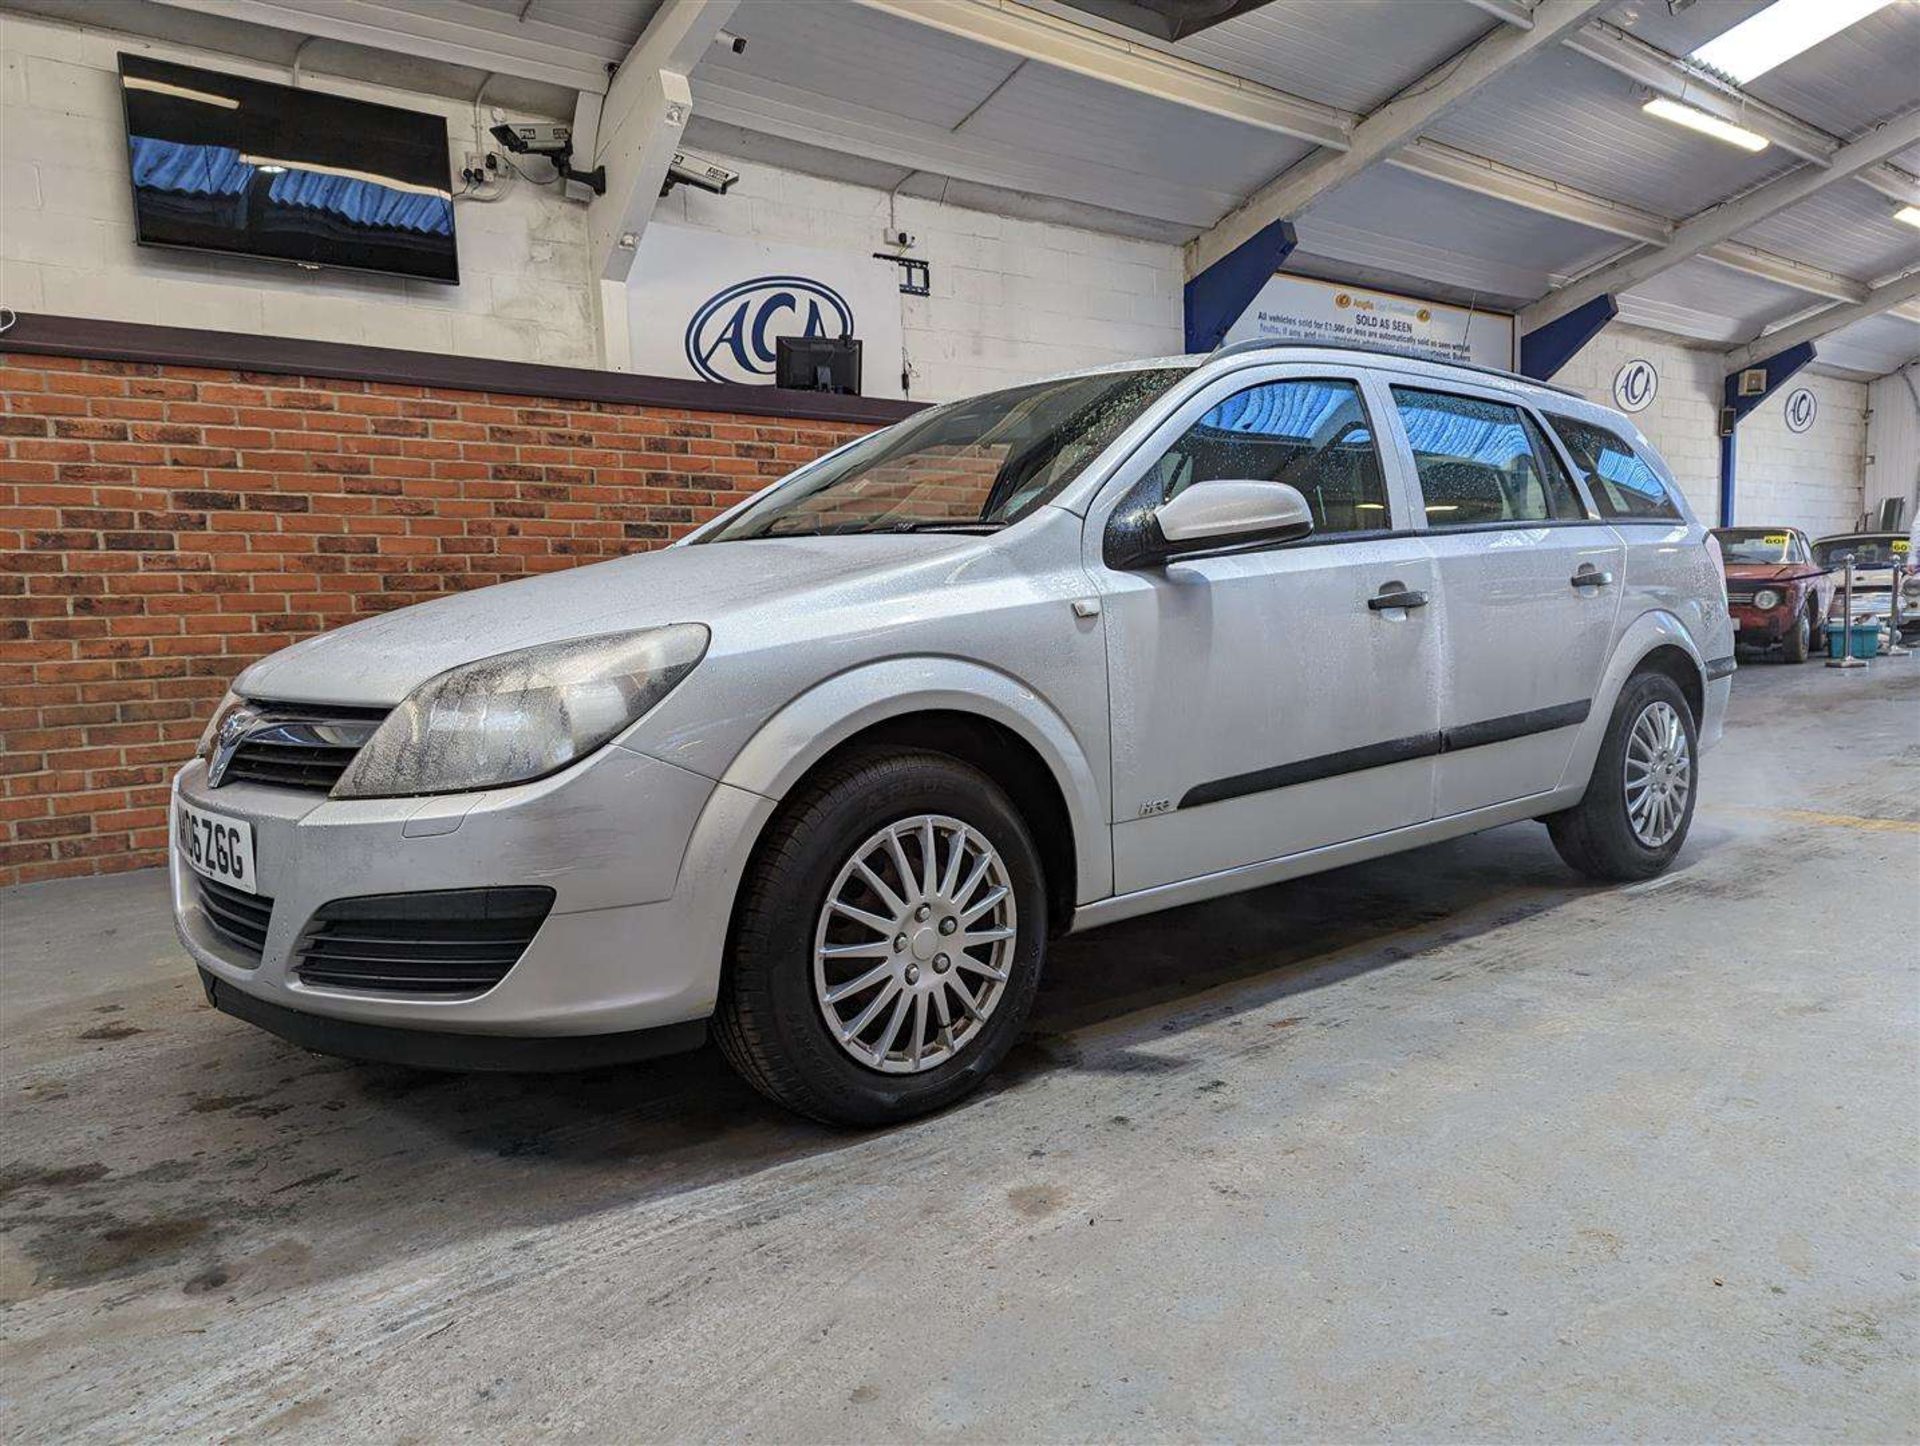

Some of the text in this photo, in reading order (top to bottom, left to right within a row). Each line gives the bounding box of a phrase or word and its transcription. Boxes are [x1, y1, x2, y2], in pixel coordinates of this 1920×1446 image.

[1258, 311, 1268, 320] All
[1269, 314, 1297, 325] vehicles
[1298, 319, 1312, 328] sold
[1313, 319, 1324, 329] for
[1346, 326, 1354, 334] or
[1354, 326, 1367, 337] less
[1368, 330, 1378, 338] are
[1379, 330, 1416, 345] automatically
[1356, 314, 1413, 333] SOLD AS SEEN
[1617, 365, 1651, 405] ACA
